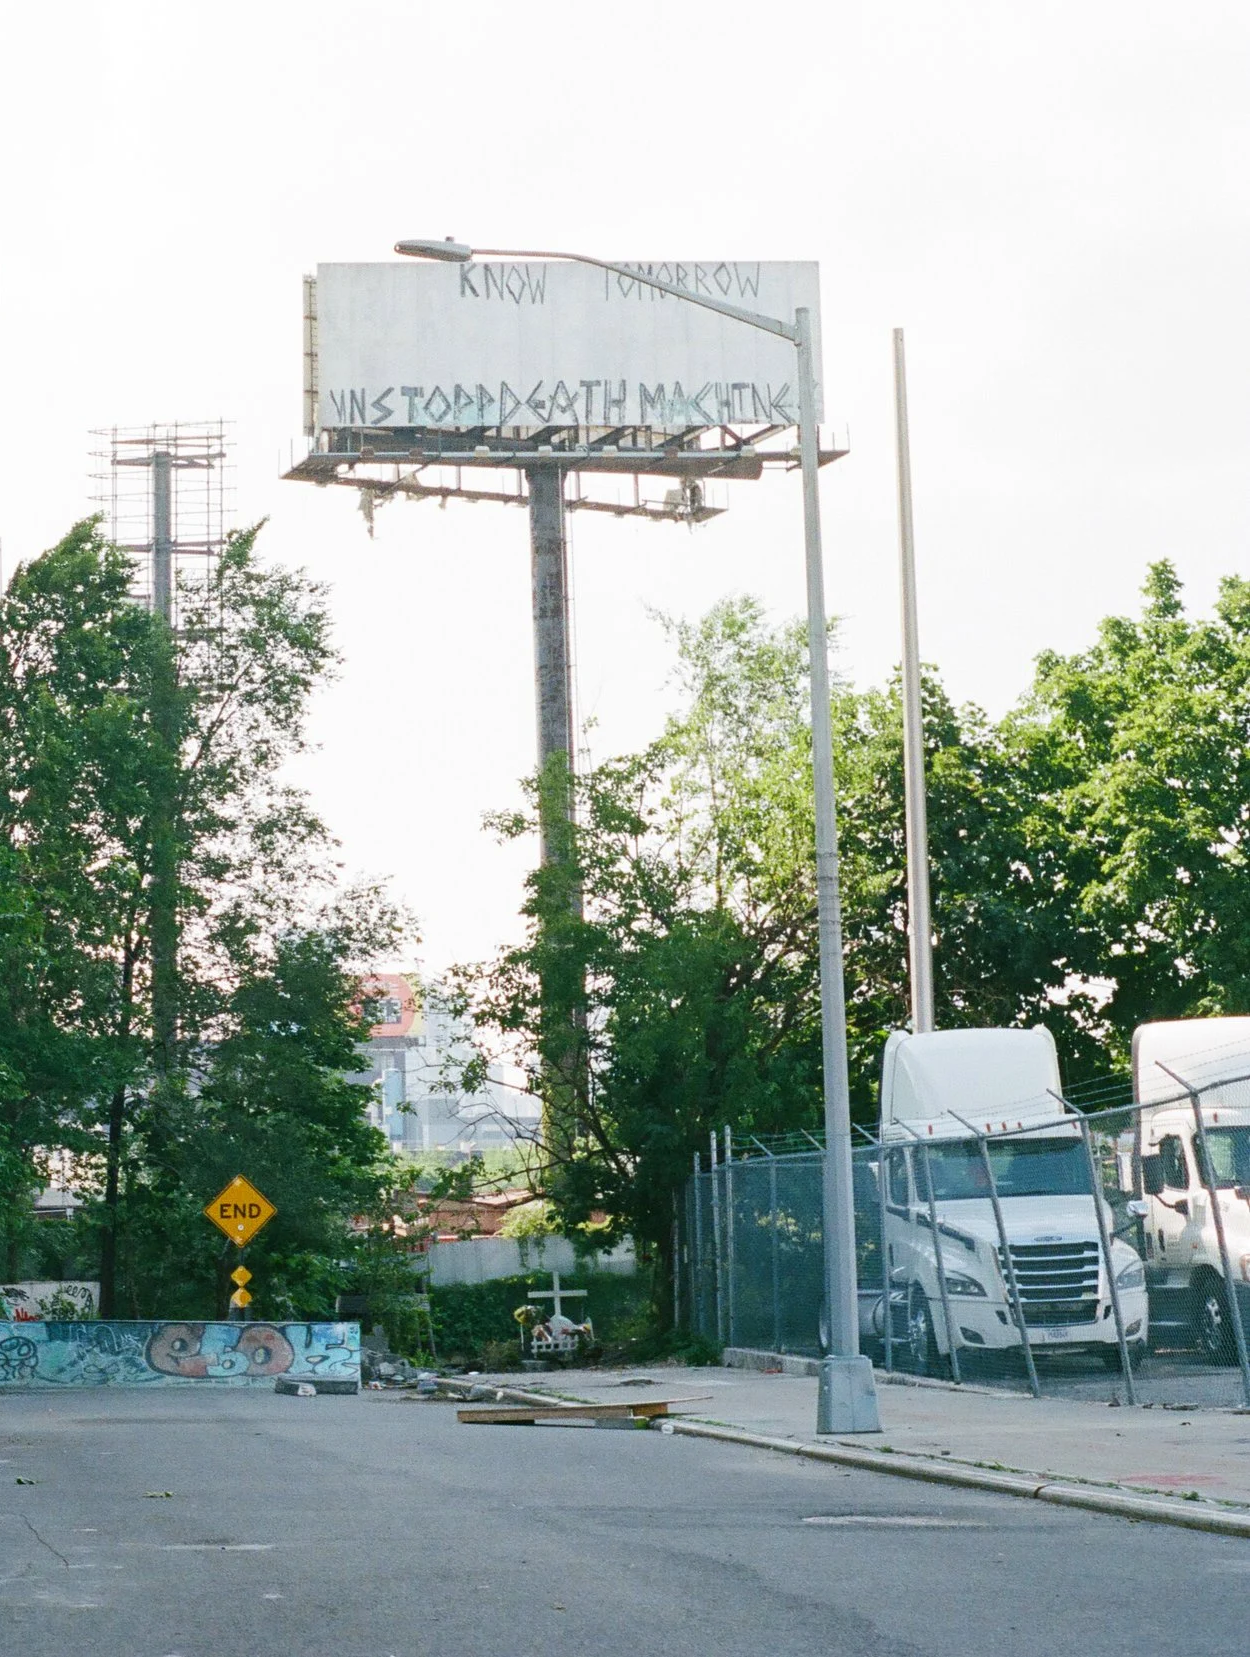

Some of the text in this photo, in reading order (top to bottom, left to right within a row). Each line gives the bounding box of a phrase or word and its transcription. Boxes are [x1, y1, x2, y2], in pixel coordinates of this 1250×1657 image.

[459, 263, 547, 305] KNOW
[639, 380, 818, 426] MACHINE
[219, 1203, 262, 1219] END
